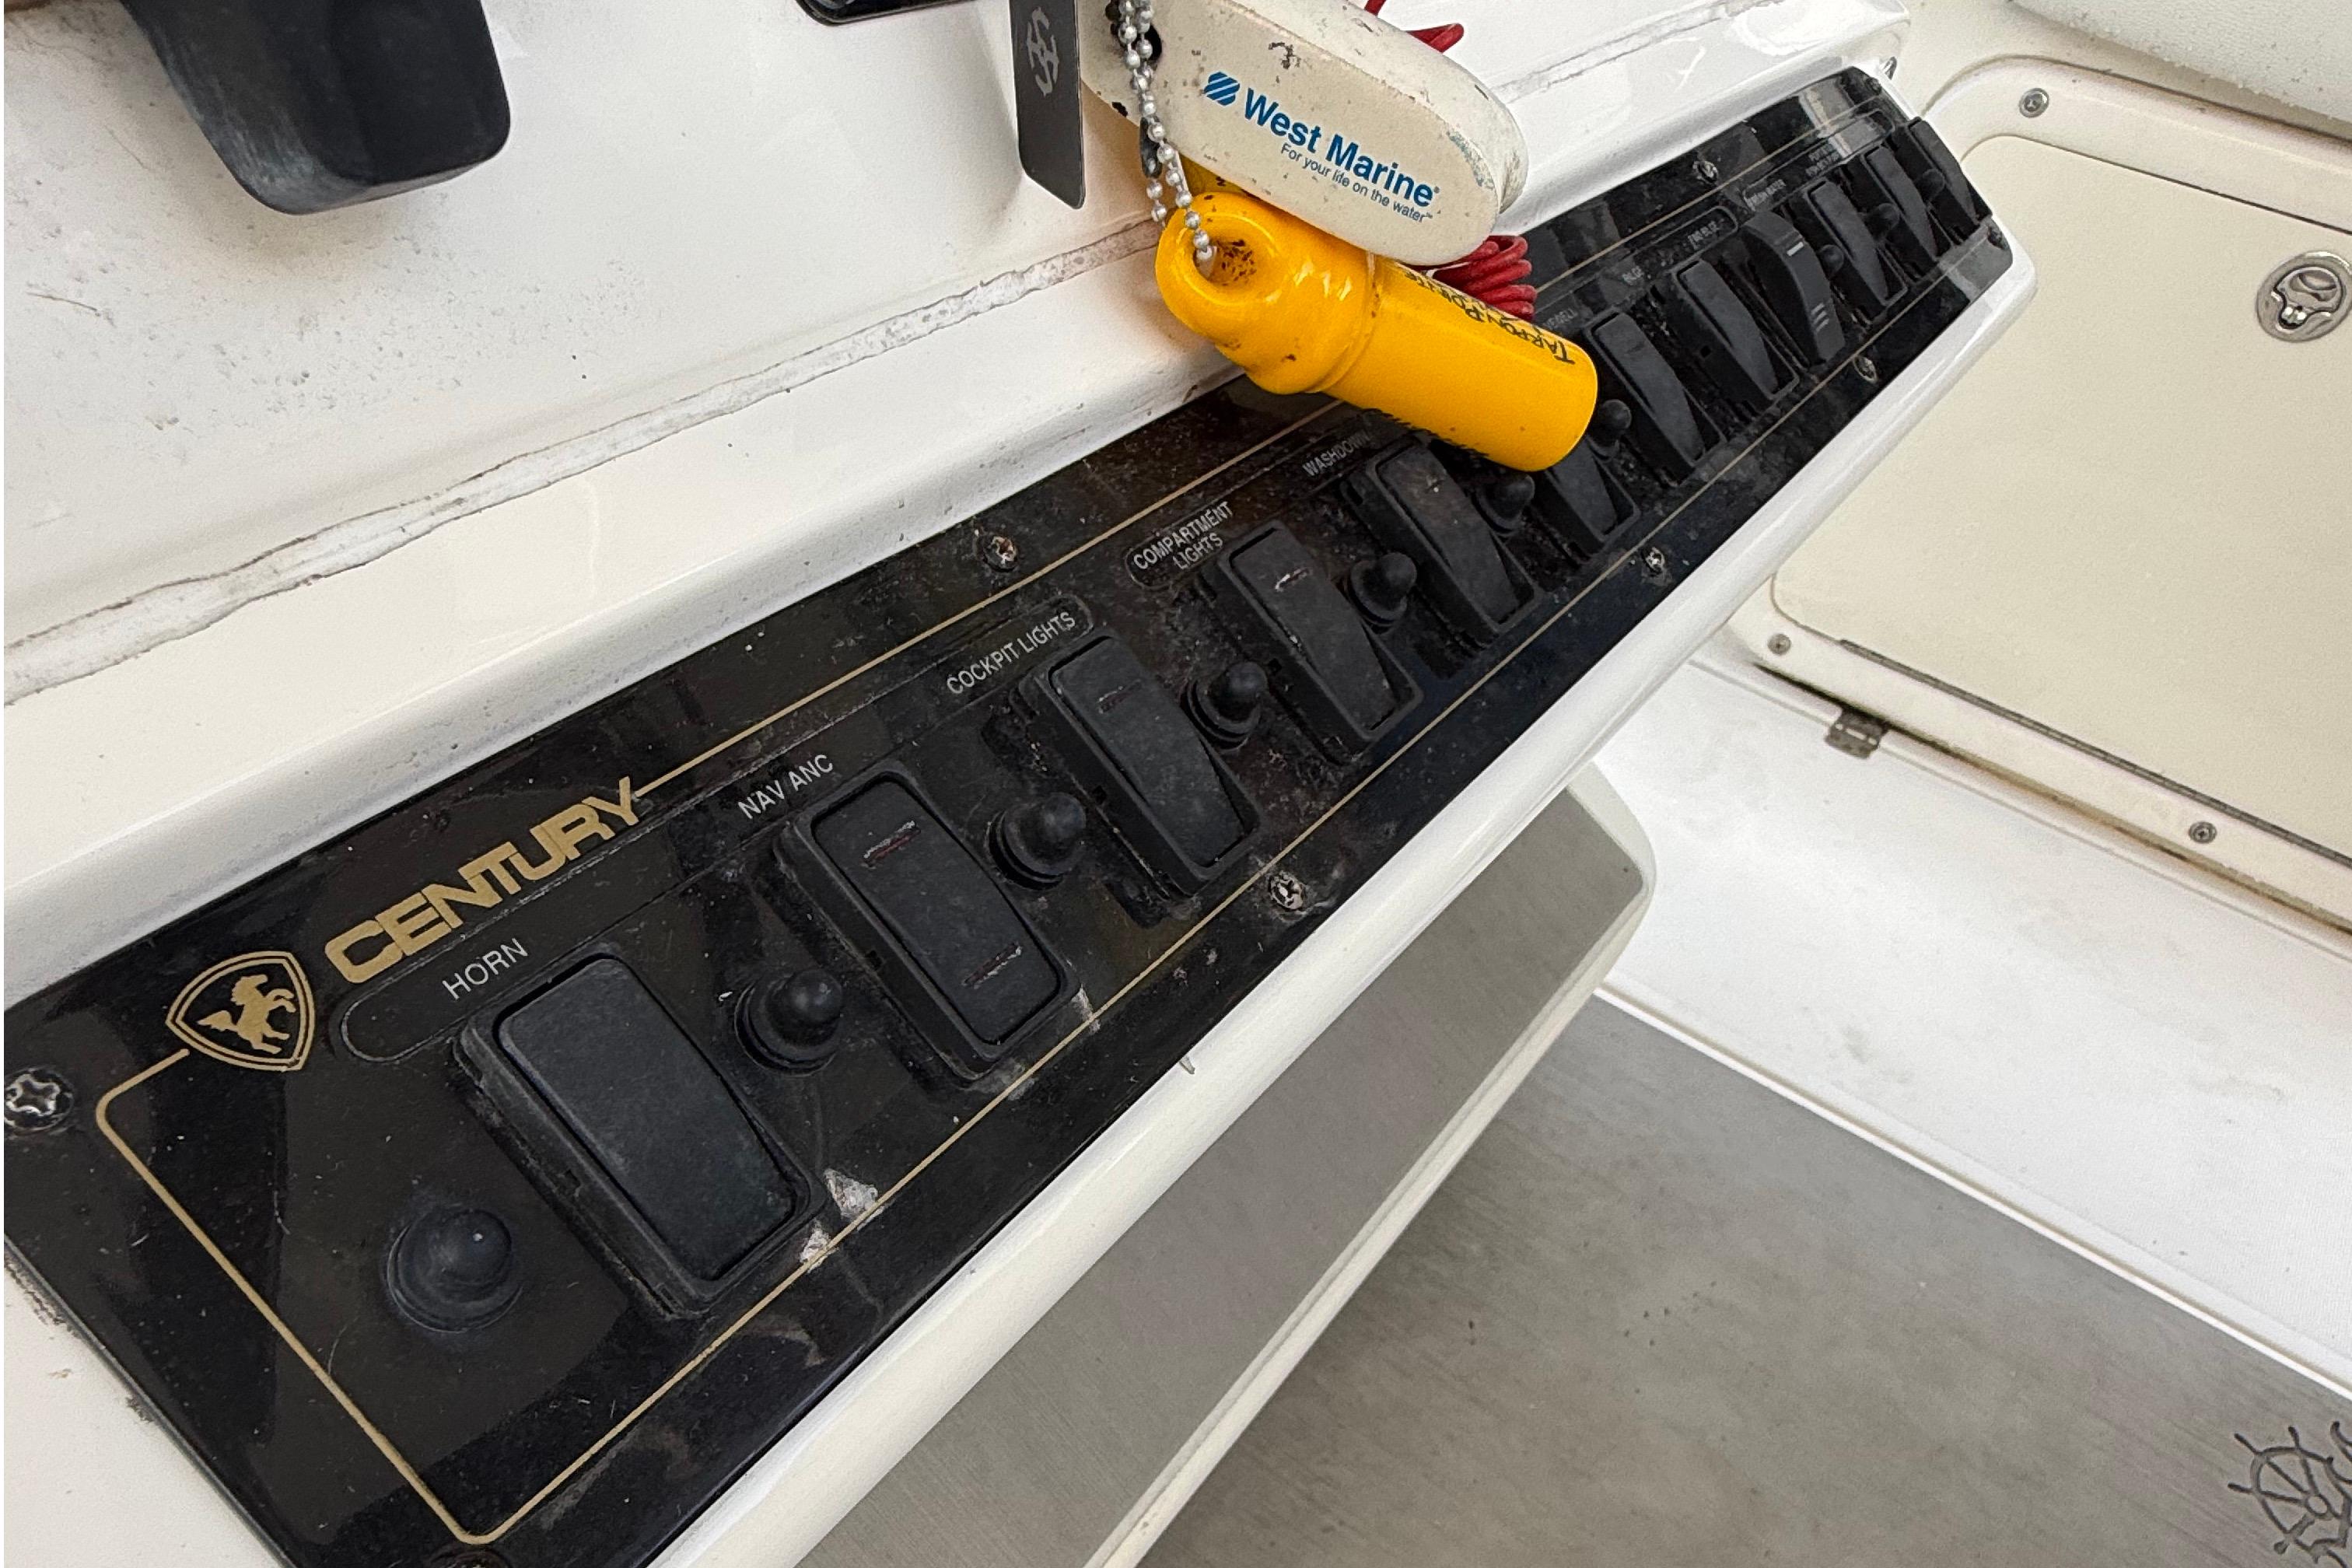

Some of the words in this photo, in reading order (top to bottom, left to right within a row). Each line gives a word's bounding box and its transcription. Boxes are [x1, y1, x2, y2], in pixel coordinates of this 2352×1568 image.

[1244, 87, 1321, 153] West
[1325, 134, 1433, 207] Marine
[1281, 143, 1303, 162] For
[1302, 157, 1332, 177] your
[1332, 169, 1350, 187] life
[1353, 182, 1368, 197] on
[1370, 189, 1390, 206] the
[1302, 429, 1371, 477] WASHDOWN
[1133, 502, 1233, 569] COMPARTMENT
[1173, 532, 1223, 569] LIGHTS
[947, 642, 1020, 695] COCKPIT
[1017, 611, 1076, 653] LIGHTS
[738, 779, 785, 819] NAV
[789, 754, 833, 792] ANC
[324, 776, 639, 984] CENTURY
[443, 937, 530, 1002] HORN
